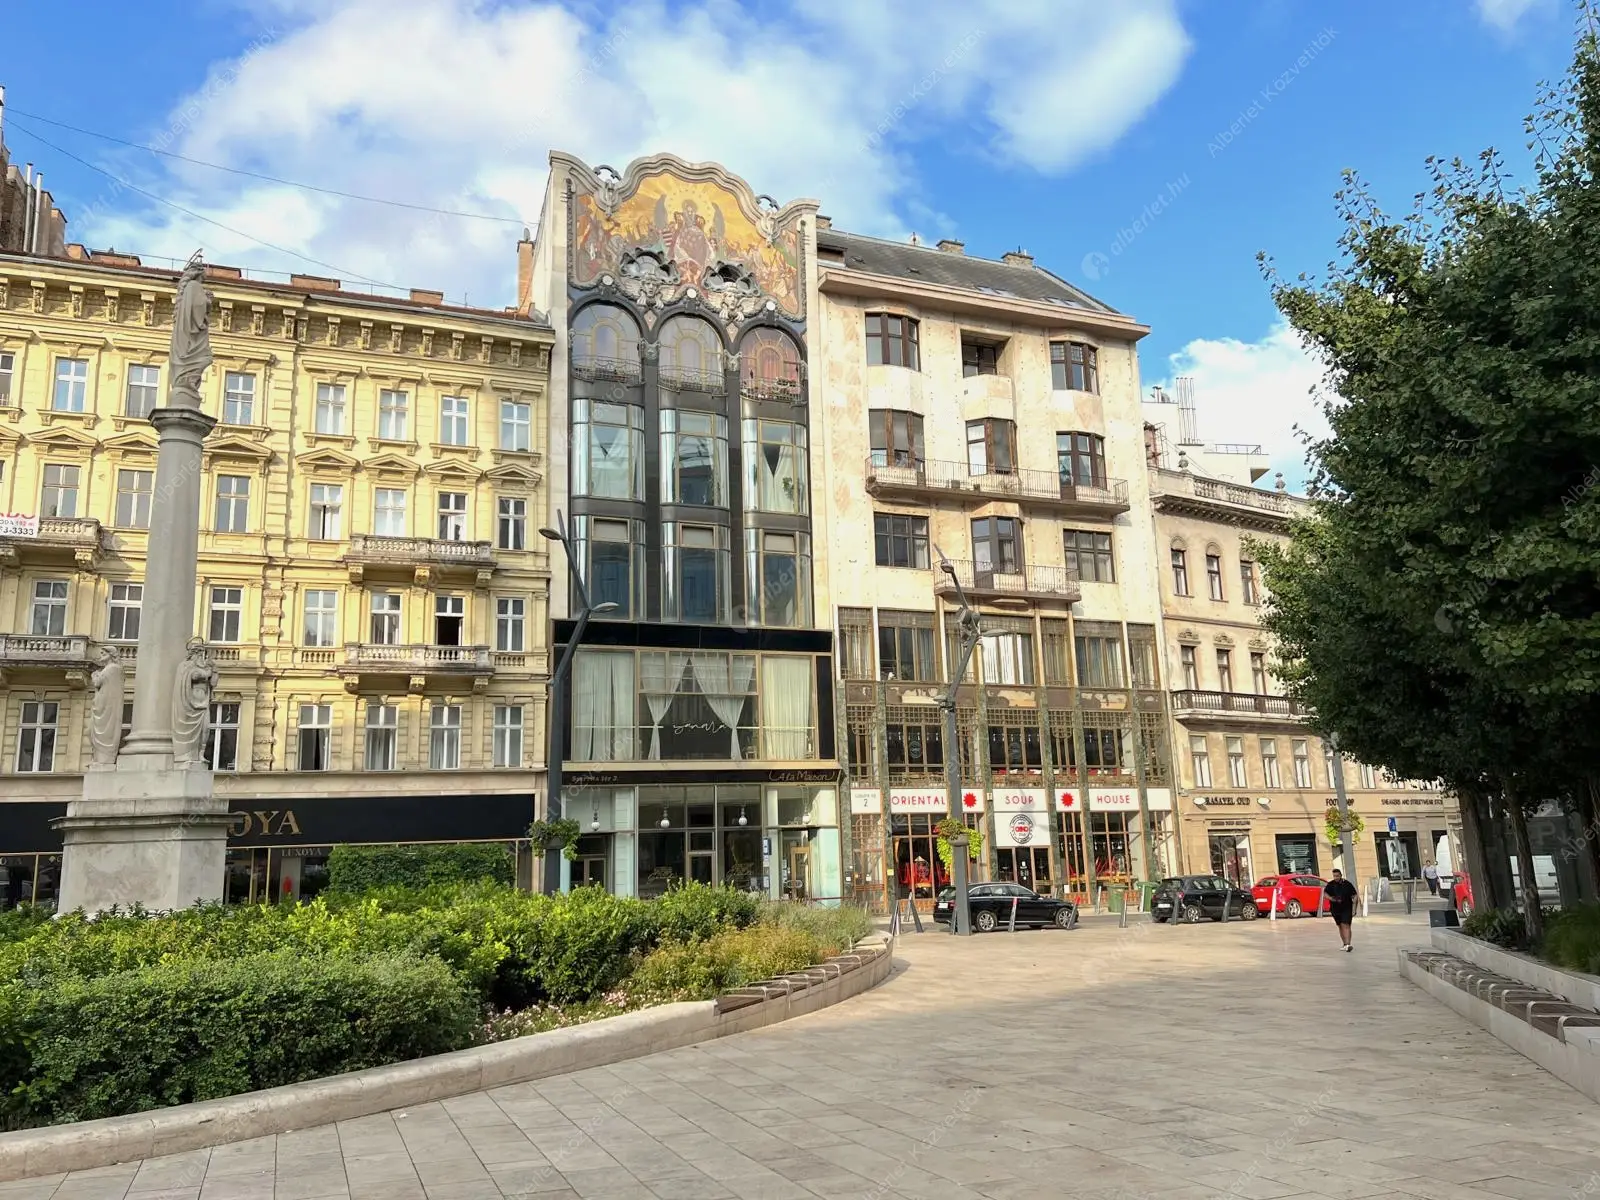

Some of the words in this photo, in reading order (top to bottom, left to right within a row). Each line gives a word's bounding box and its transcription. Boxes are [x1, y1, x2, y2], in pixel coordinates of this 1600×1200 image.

[891, 796, 946, 805] ORIENTAL
[1005, 795, 1034, 805] SOUP
[1097, 795, 1131, 804] HOUSE
